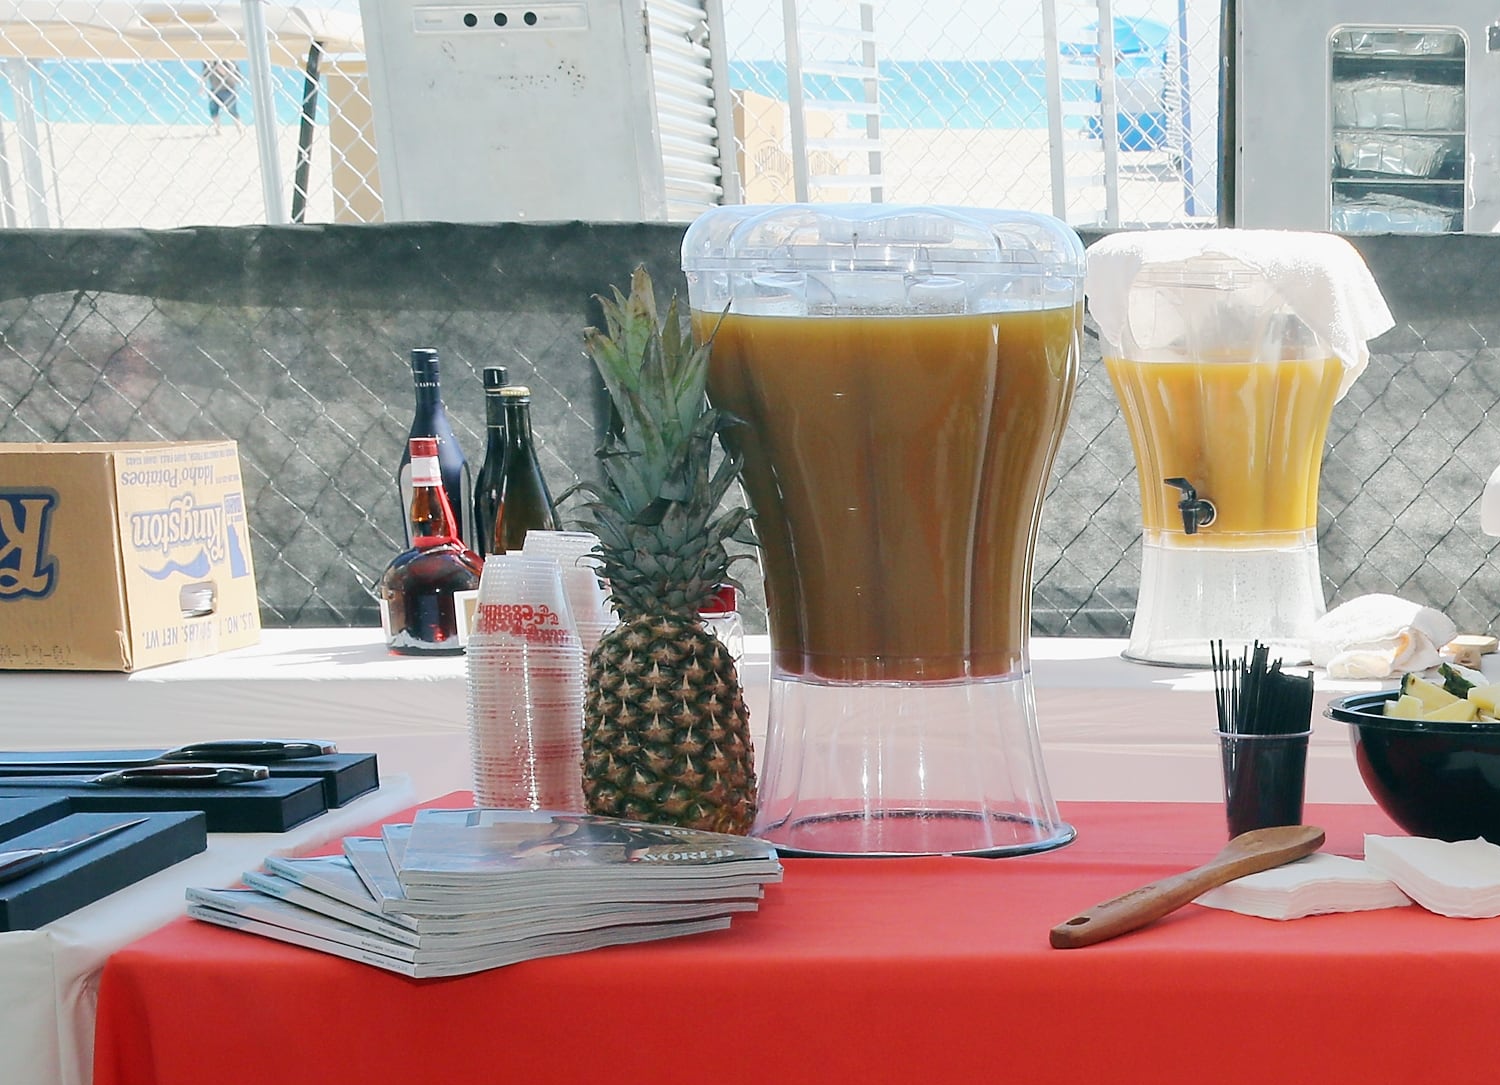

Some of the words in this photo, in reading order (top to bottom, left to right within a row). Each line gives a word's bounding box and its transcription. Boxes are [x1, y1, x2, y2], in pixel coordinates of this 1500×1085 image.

[120, 467, 179, 488] Potatoes
[181, 464, 214, 486] Idaho
[130, 494, 225, 564] Kingston
[141, 629, 160, 649] WT.
[162, 626, 178, 647] NET
